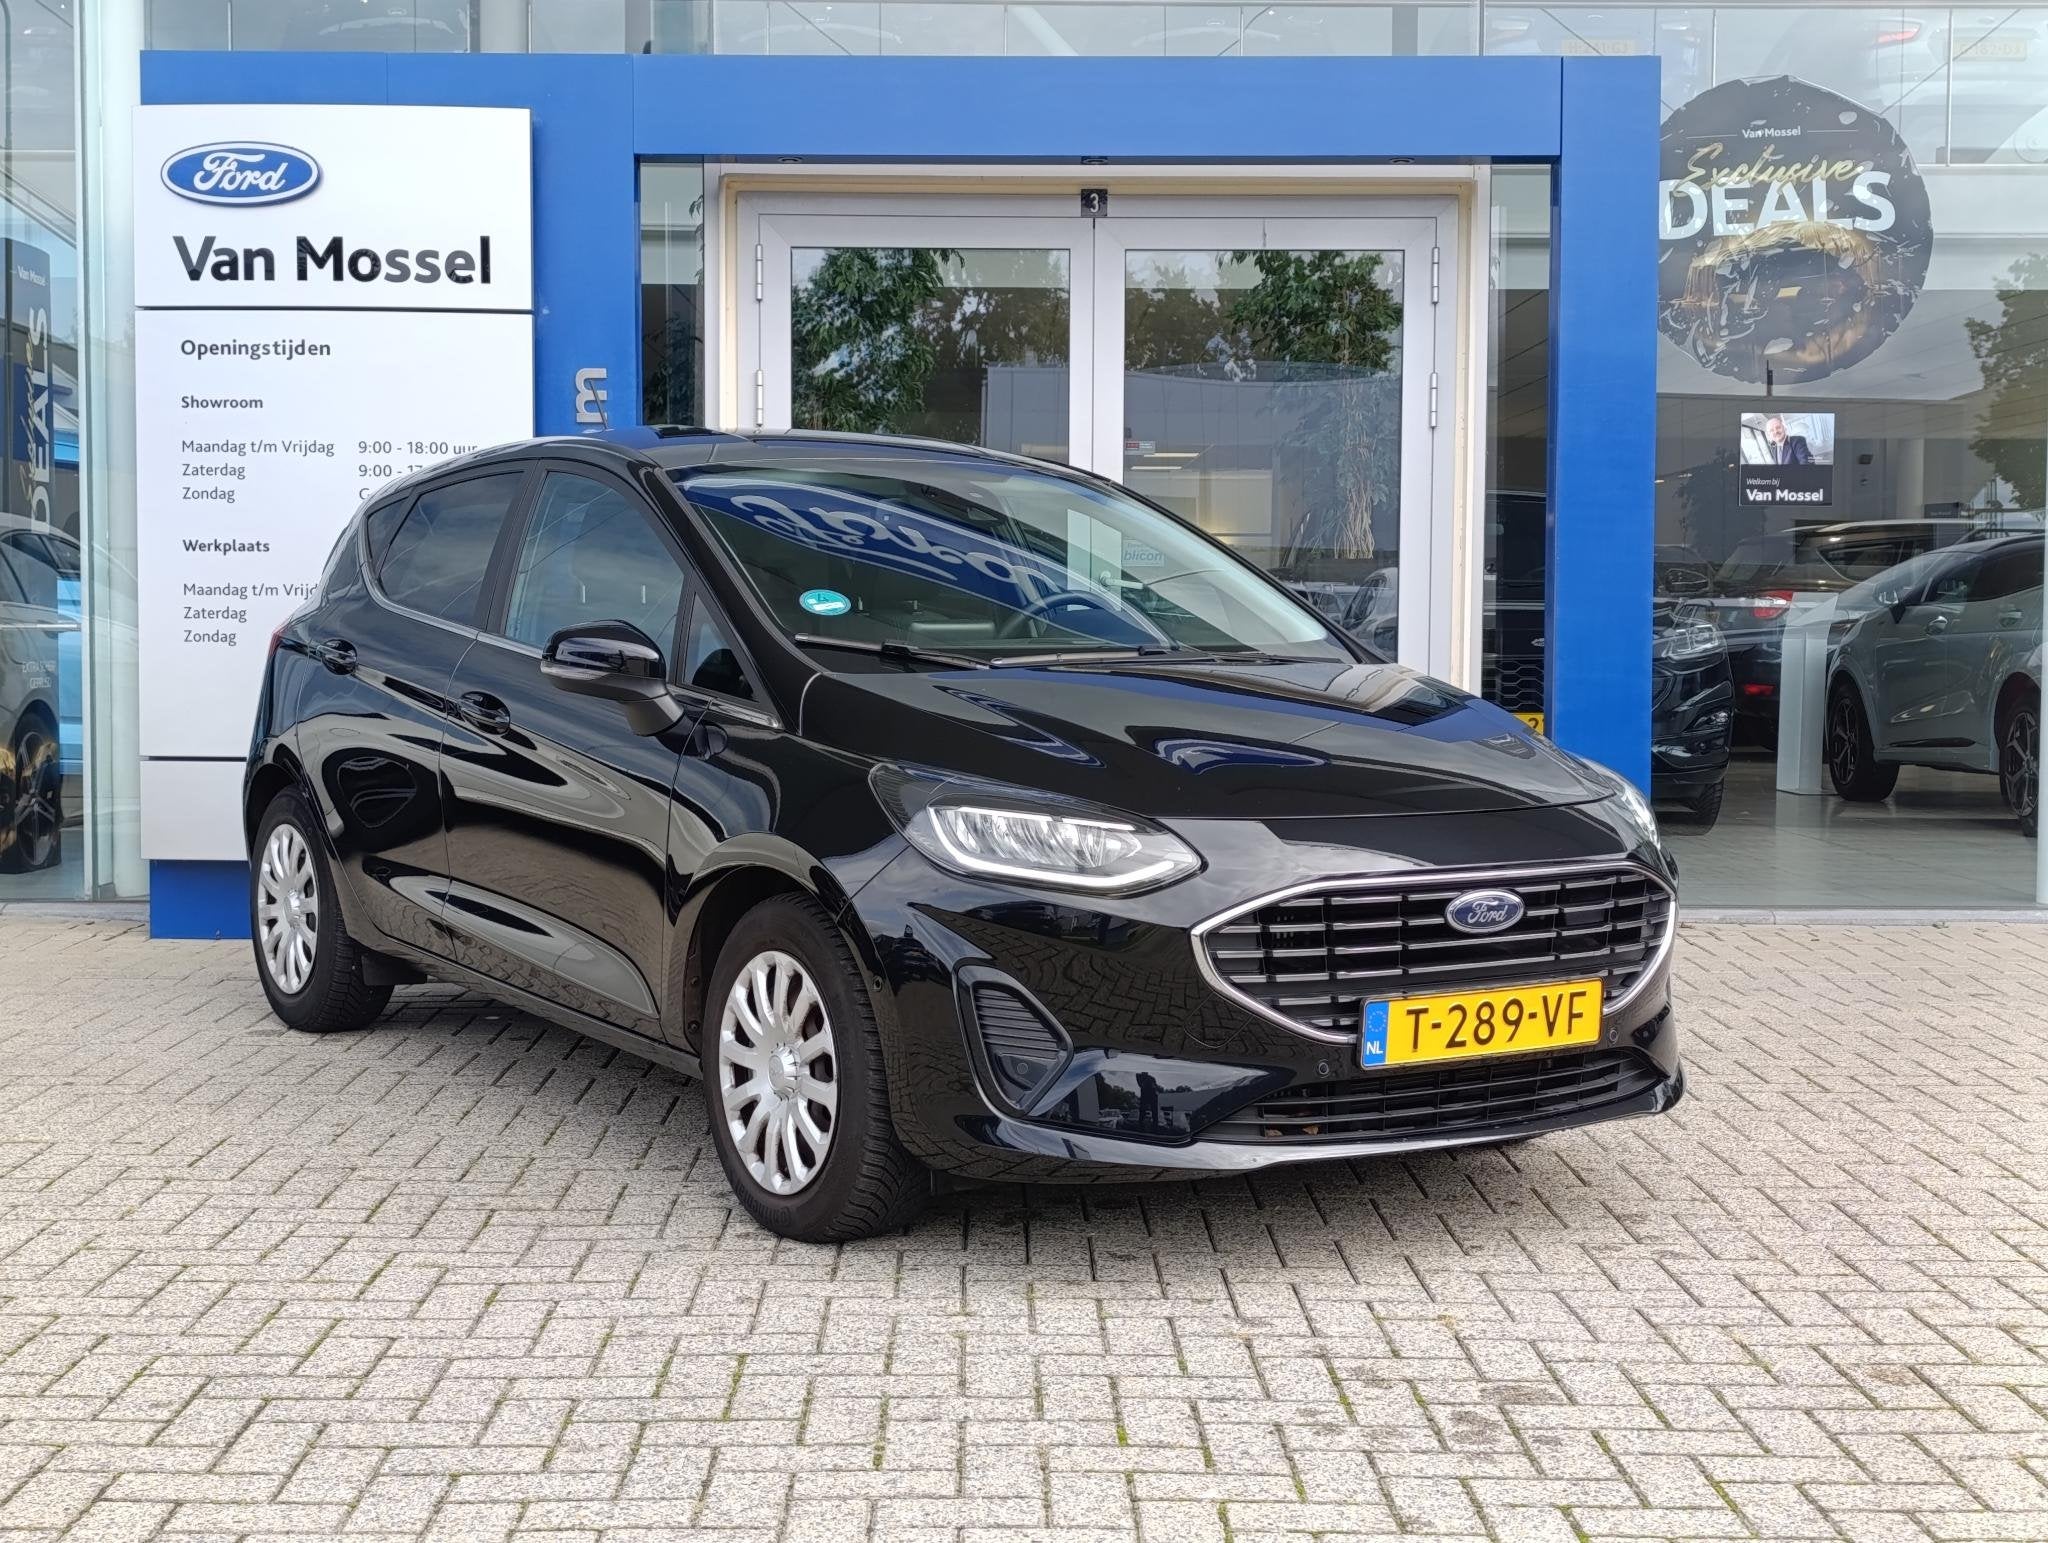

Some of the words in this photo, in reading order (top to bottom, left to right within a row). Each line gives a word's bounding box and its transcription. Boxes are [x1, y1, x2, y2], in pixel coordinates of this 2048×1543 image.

[1742, 128, 1762, 138] Van
[1764, 126, 1801, 137] Mossel
[194, 151, 289, 192] Ford
[1673, 143, 1870, 197] Exclusive
[1090, 193, 1100, 213] 3
[1659, 171, 1896, 239] DEALS
[172, 236, 275, 282] Van
[296, 236, 491, 284] Mossel
[181, 339, 331, 361] Openingstijden
[181, 395, 264, 409] Showroom
[29, 307, 50, 533] DEALS
[182, 440, 246, 457] Maandag
[250, 440, 278, 454] t/m
[282, 440, 335, 457] Vrijdag
[358, 441, 392, 454] 9:00
[407, 441, 449, 455] 18:00
[182, 463, 246, 480] Zaterdag
[358, 464, 392, 477] 9:00
[182, 486, 236, 503] Zondag
[1746, 489, 1772, 501] Van
[1775, 489, 1824, 501] Mossel
[182, 539, 271, 555] Werkplaats
[184, 583, 248, 600] Maandag
[252, 583, 279, 597] t/m
[283, 584, 318, 600] Vrijd
[184, 606, 247, 623] Zaterdag
[184, 629, 237, 647] Zondag
[1467, 900, 1509, 924] Ford
[1406, 991, 1587, 1052] T-289-VF
[1366, 1041, 1383, 1055] NL
